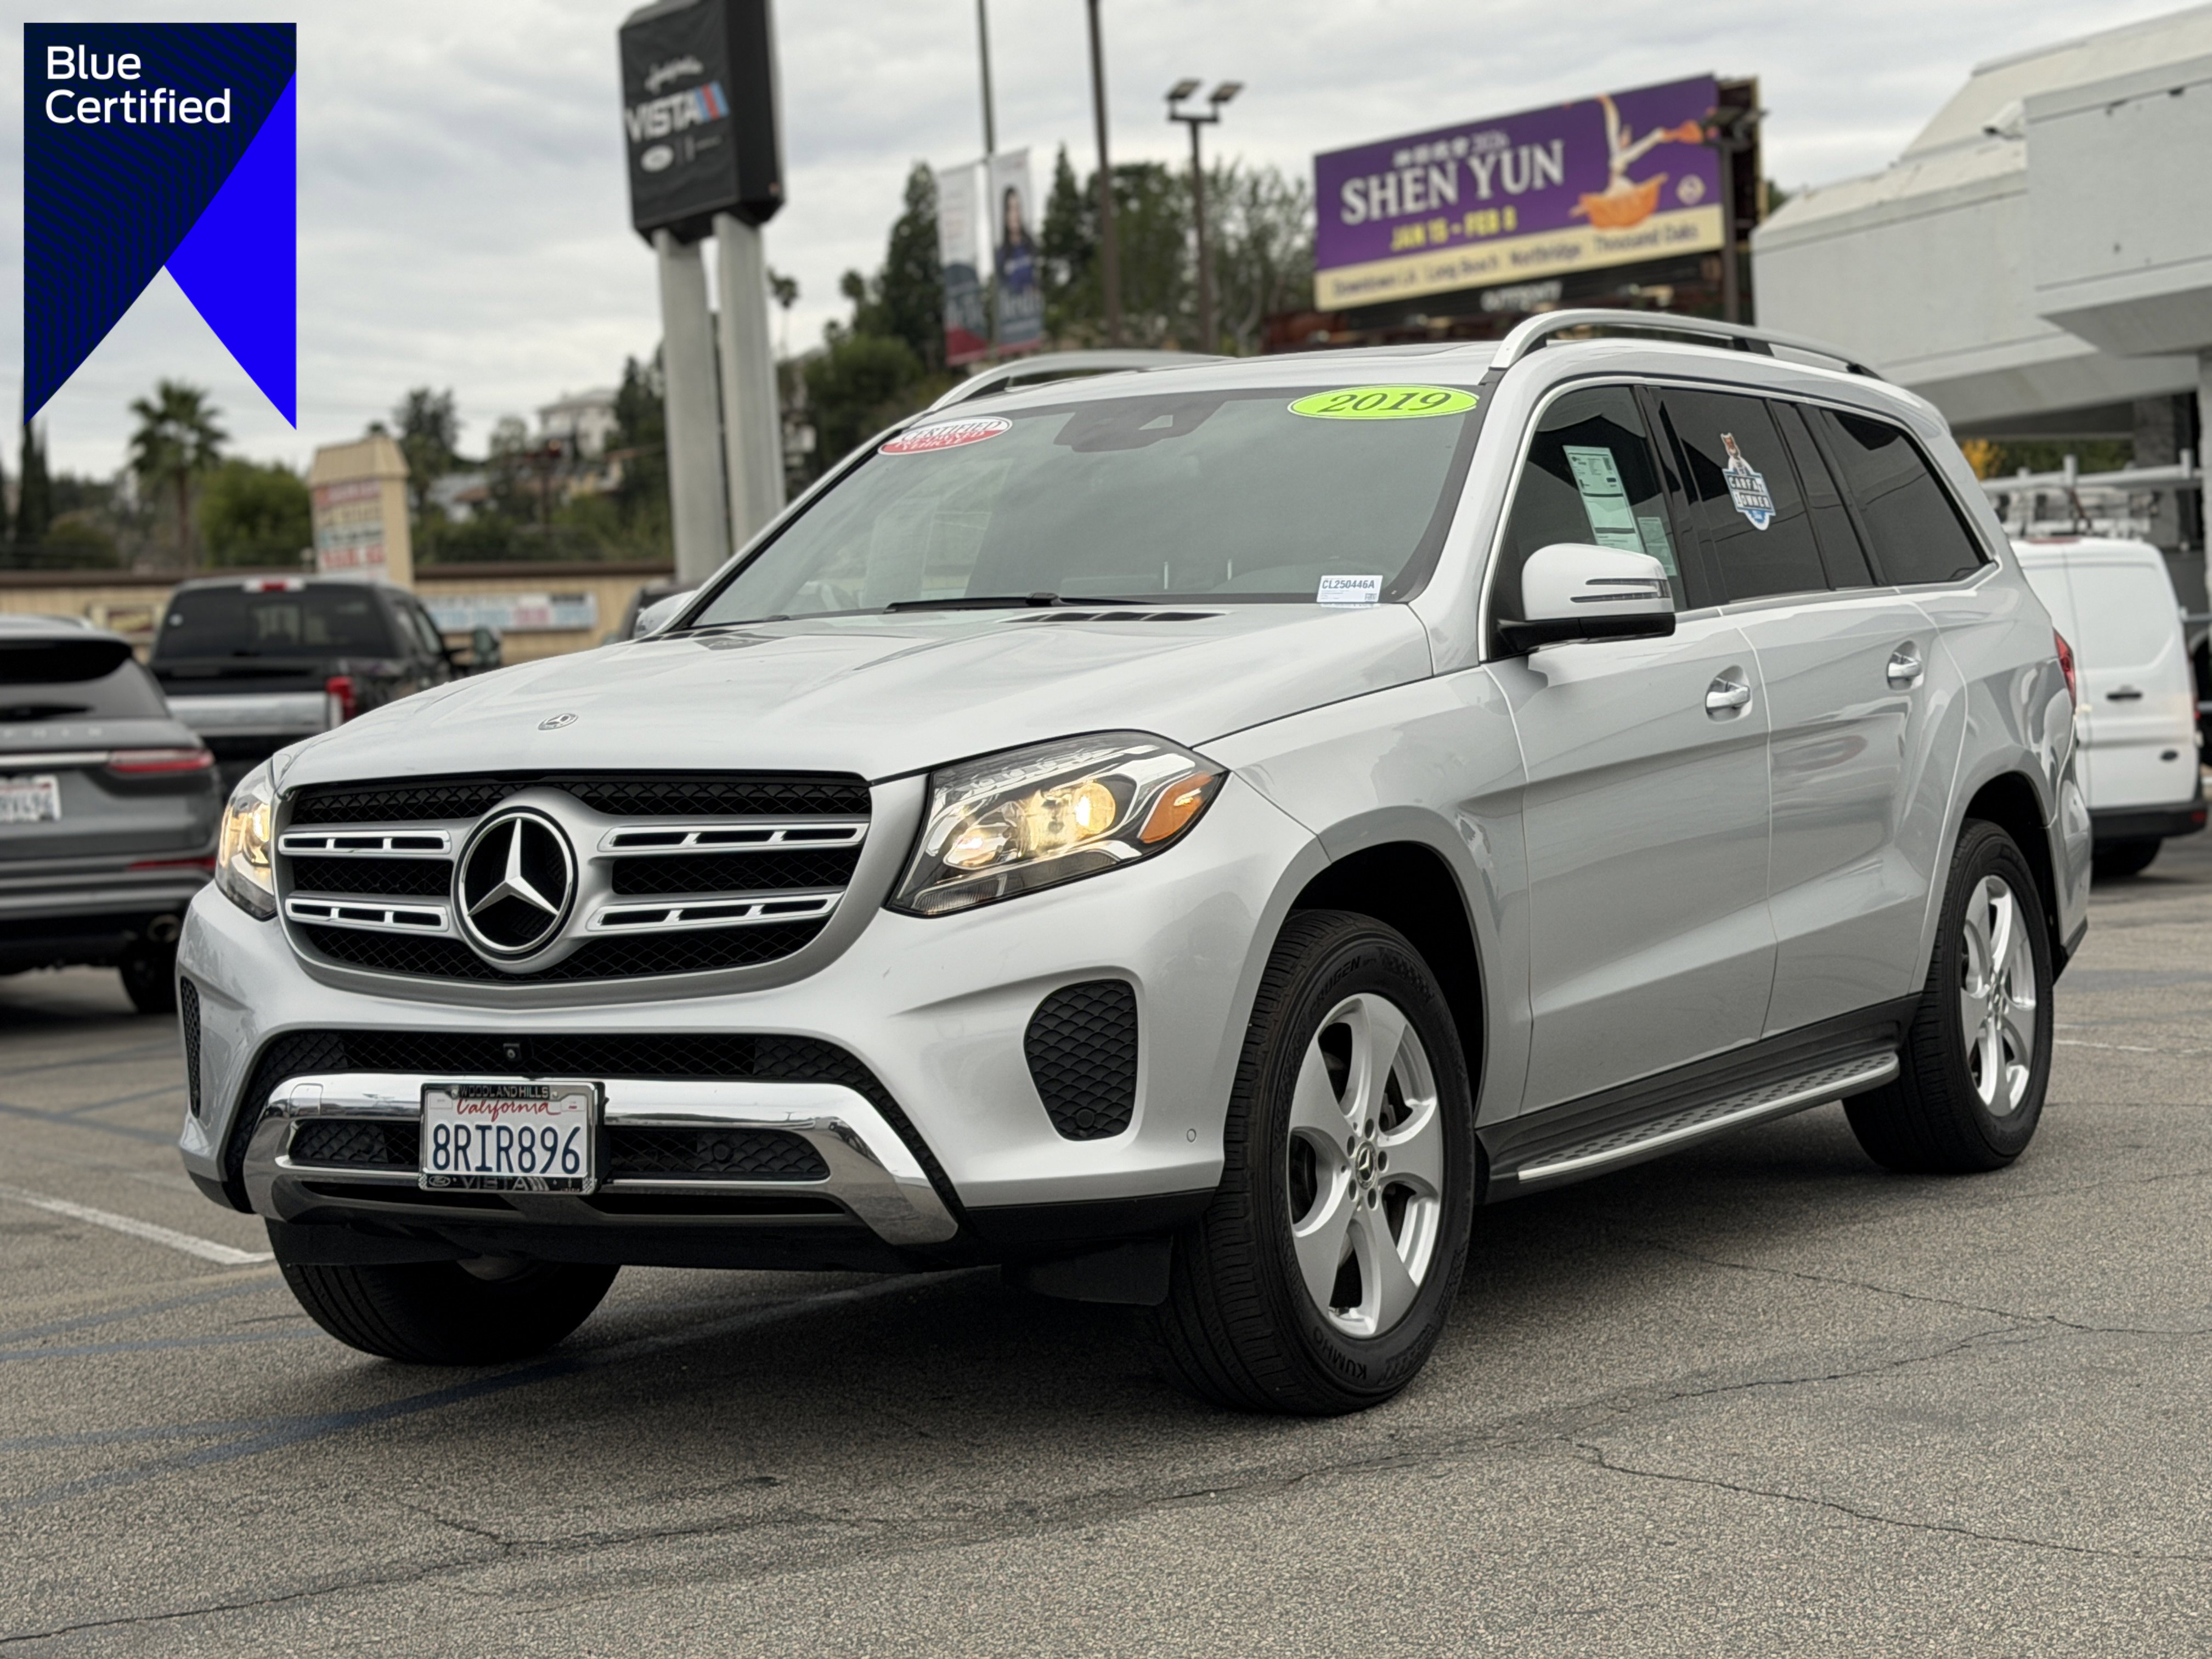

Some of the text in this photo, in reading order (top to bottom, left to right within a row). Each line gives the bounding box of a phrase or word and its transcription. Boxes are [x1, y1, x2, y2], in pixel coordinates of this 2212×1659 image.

[624, 89, 704, 144] VISTA
[1340, 159, 1459, 225] SHEN
[1468, 139, 1564, 200] YUN
[1391, 222, 1426, 252] JAN
[1464, 208, 1501, 238] FEB
[1317, 392, 1452, 413] 2019
[901, 421, 1002, 441] CERTIFIED
[1322, 580, 1375, 589] CL250446A
[460, 1086, 549, 1098] WOODLAND HILLS
[457, 1098, 562, 1122] California
[433, 1123, 580, 1174] 8RIR896
[1313, 1325, 1367, 1380] KUMHO
